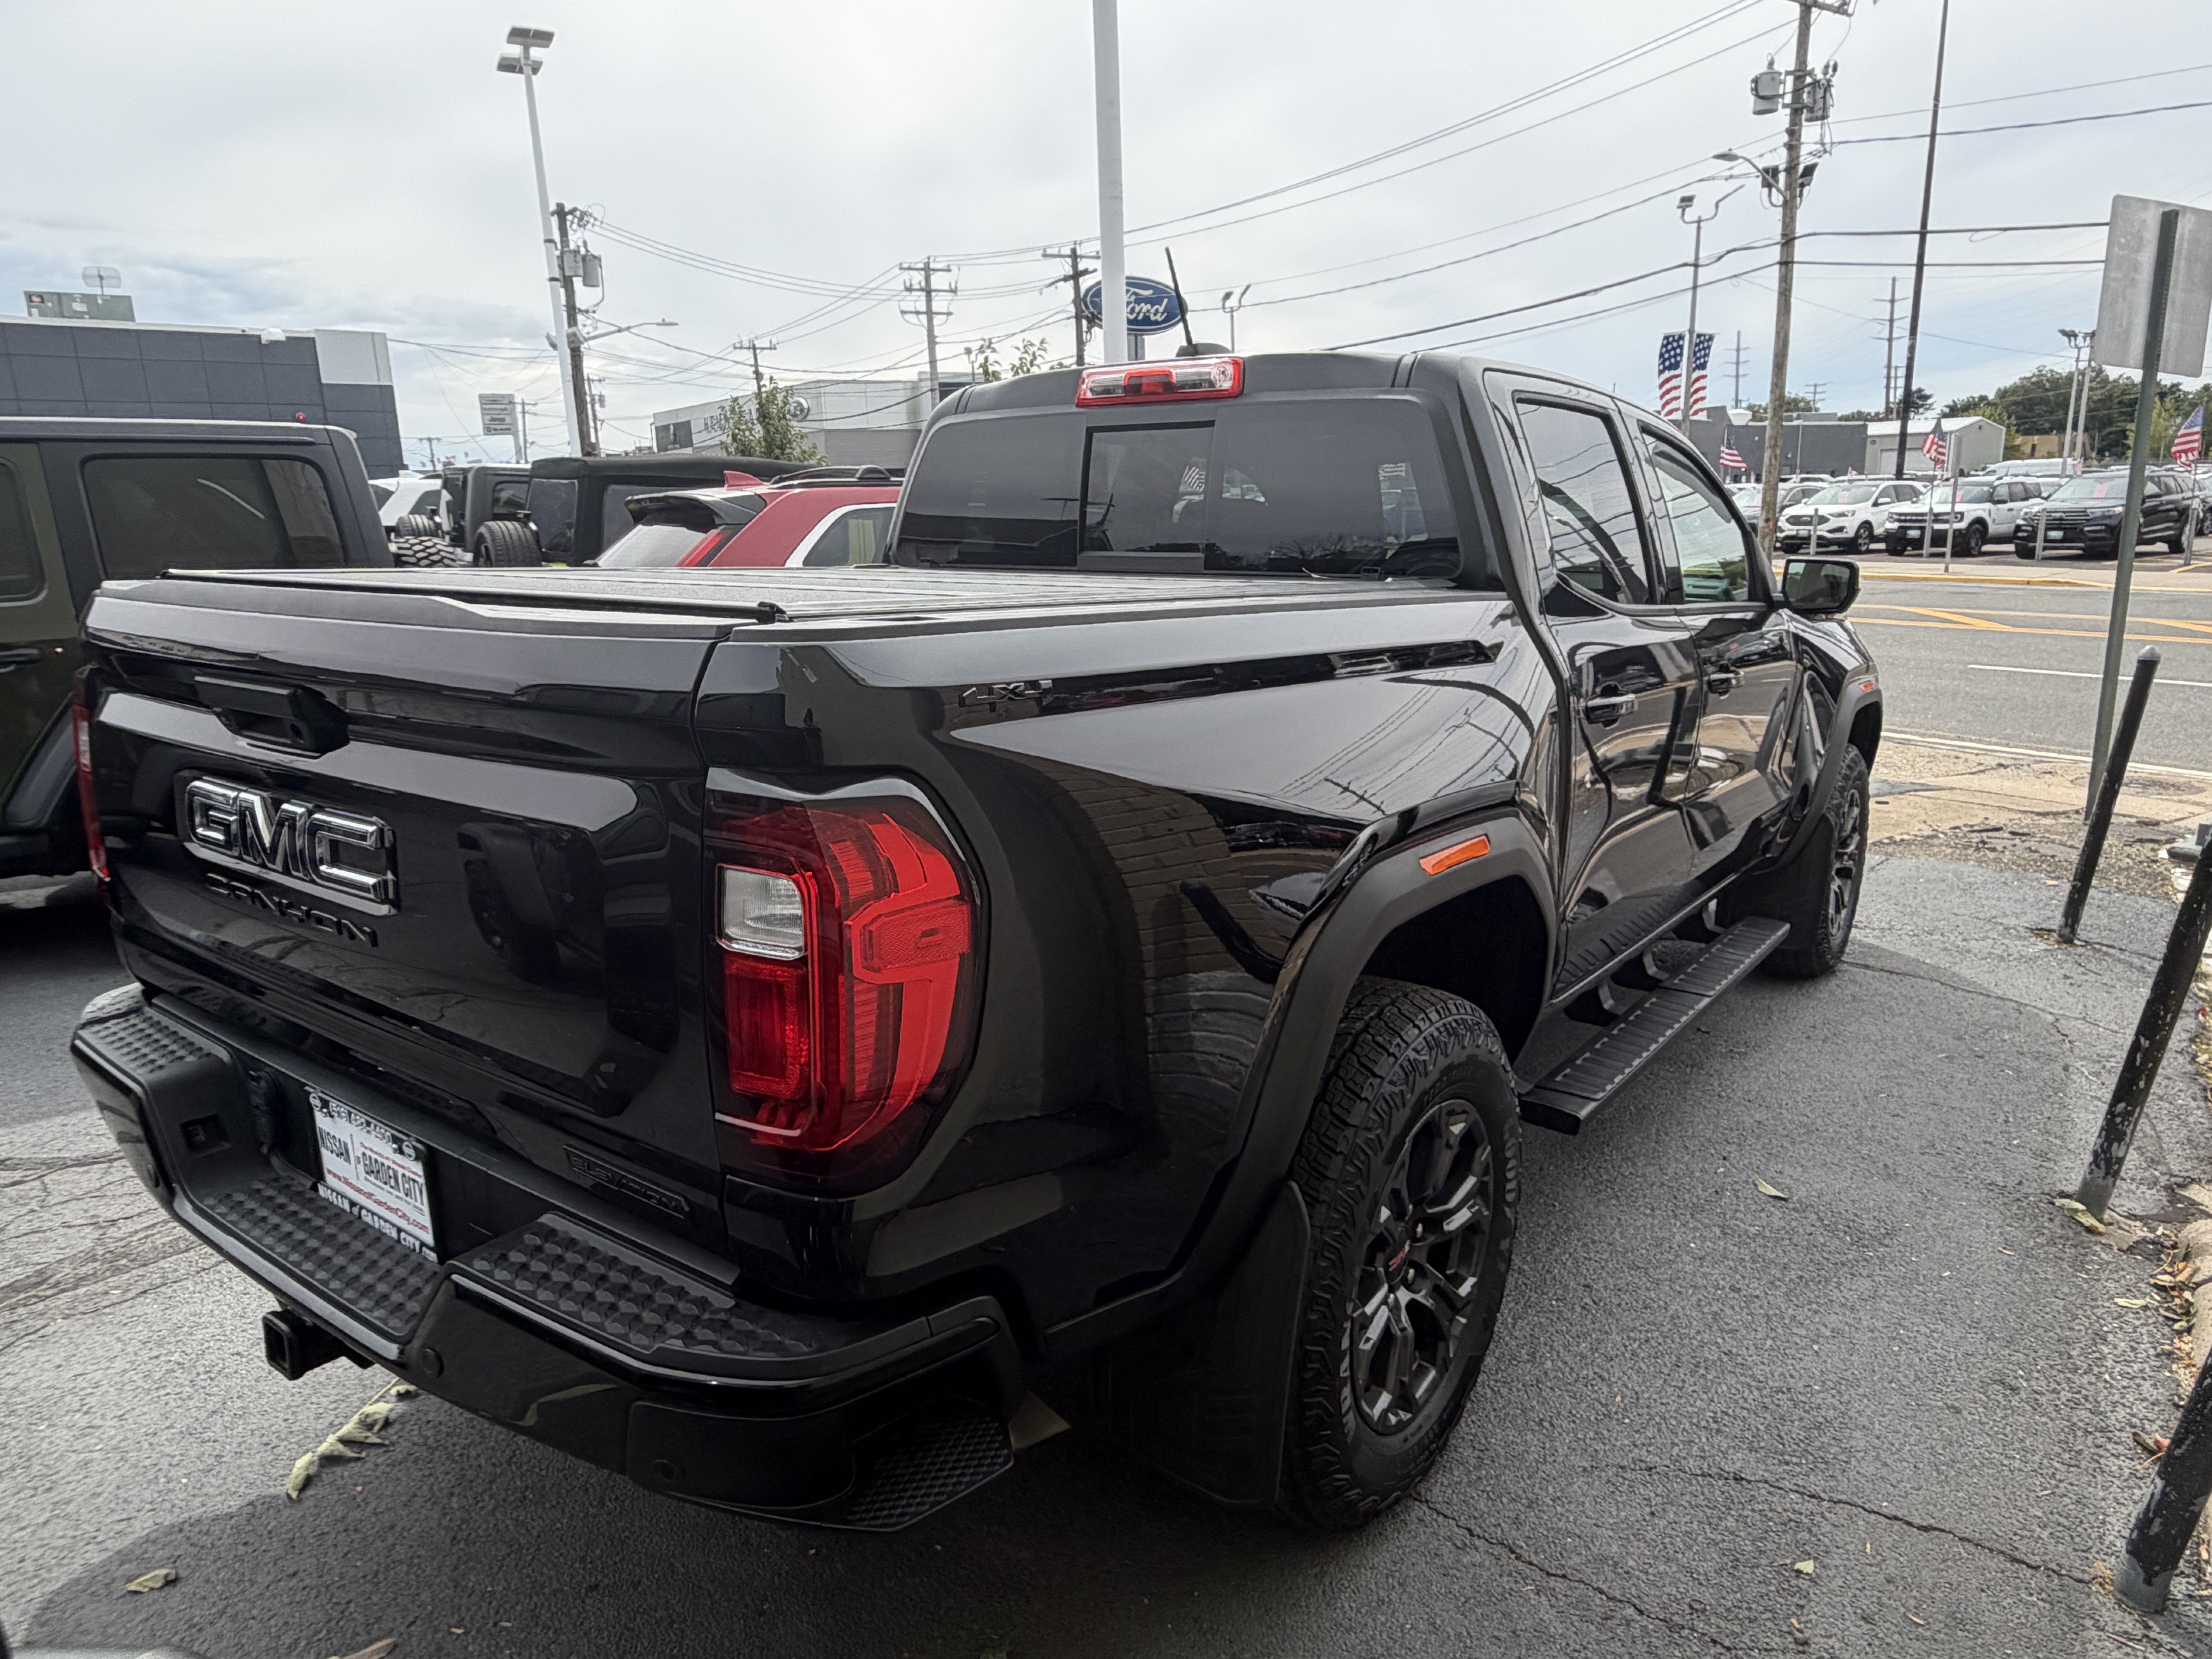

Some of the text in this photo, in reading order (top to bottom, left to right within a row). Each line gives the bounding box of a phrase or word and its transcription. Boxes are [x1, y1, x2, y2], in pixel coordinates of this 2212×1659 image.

[186, 776, 397, 903] GMC
[204, 873, 379, 948] CANYON
[318, 1126, 352, 1165] NISSAN
[362, 1152, 400, 1194] GARDEN
[402, 1172, 425, 1206] CITY
[317, 1183, 350, 1212] NISSAN
[361, 1209, 398, 1240] GARDEN
[400, 1231, 421, 1253] CITY
